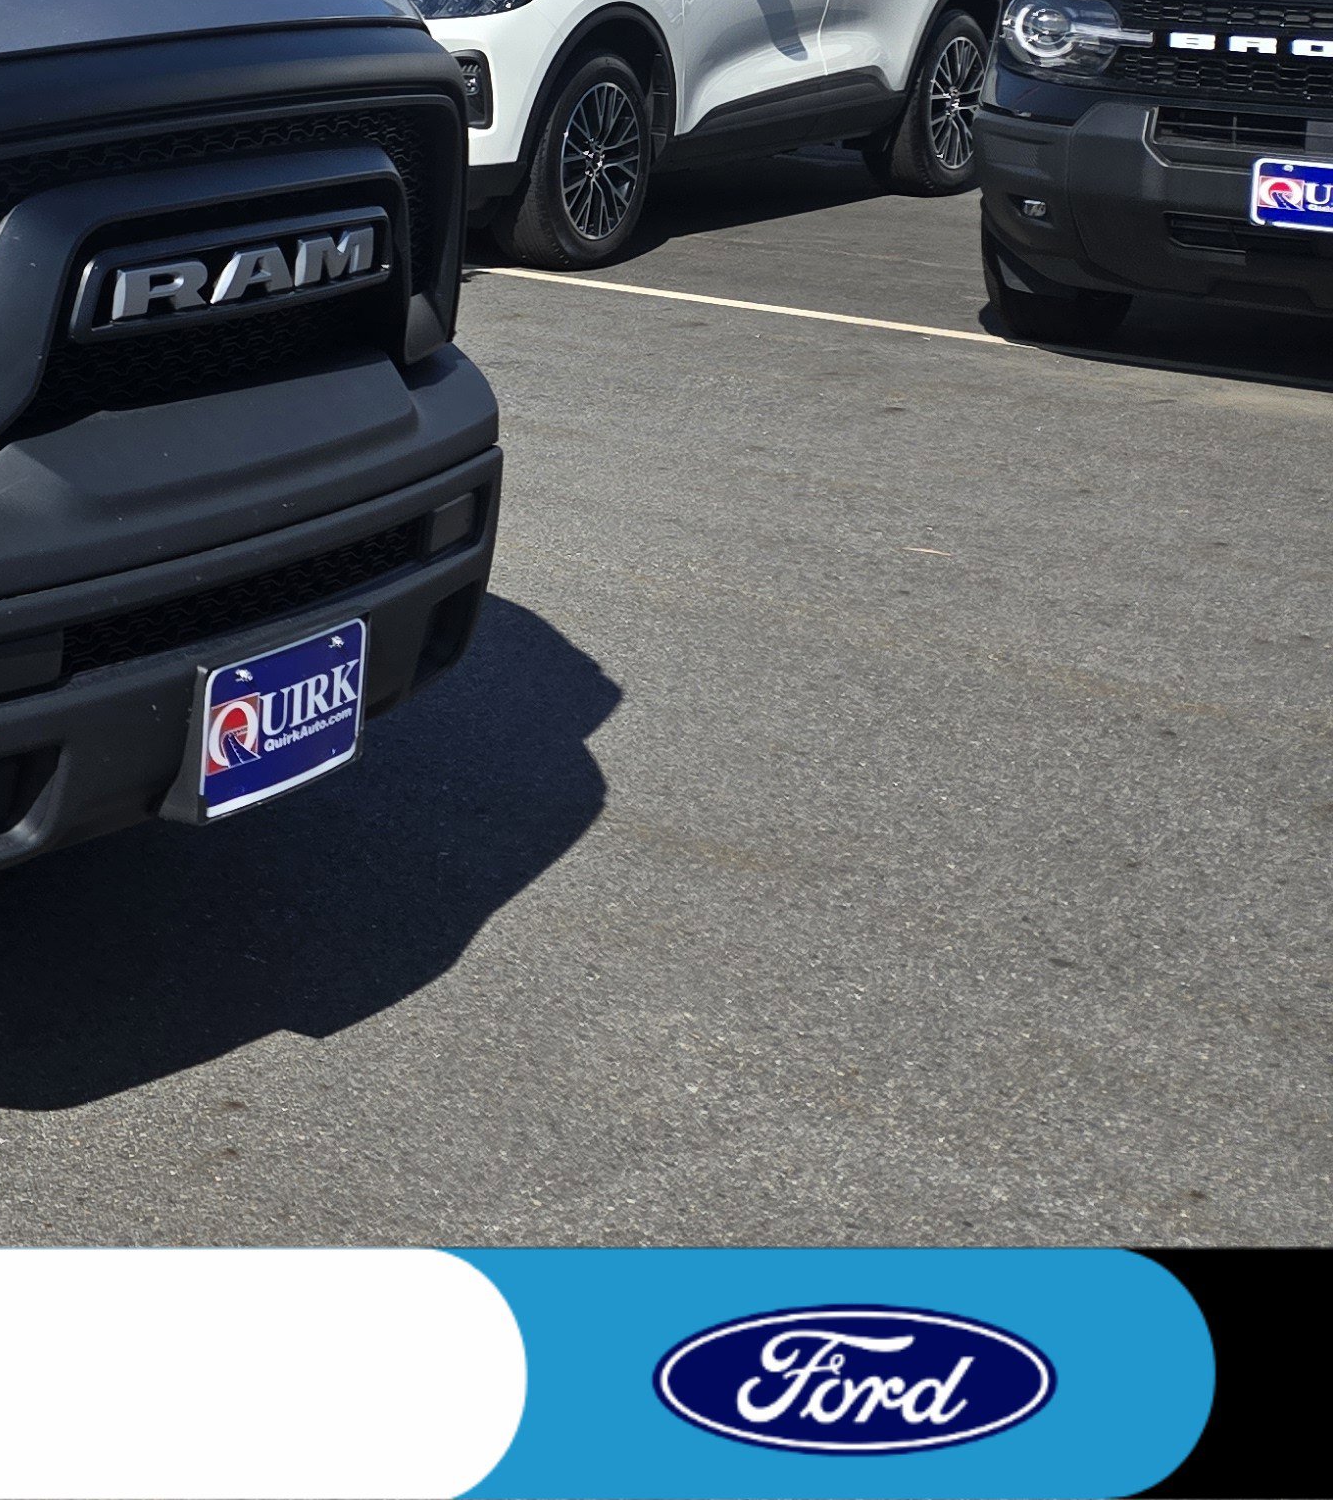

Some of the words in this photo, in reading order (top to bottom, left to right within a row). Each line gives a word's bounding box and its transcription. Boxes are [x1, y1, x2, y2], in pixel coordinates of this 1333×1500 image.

[1169, 32, 1333, 58] BRO
[111, 226, 375, 321] RAM
[208, 658, 360, 768] QUIRK
[263, 707, 353, 752] QuirkAuto.com
